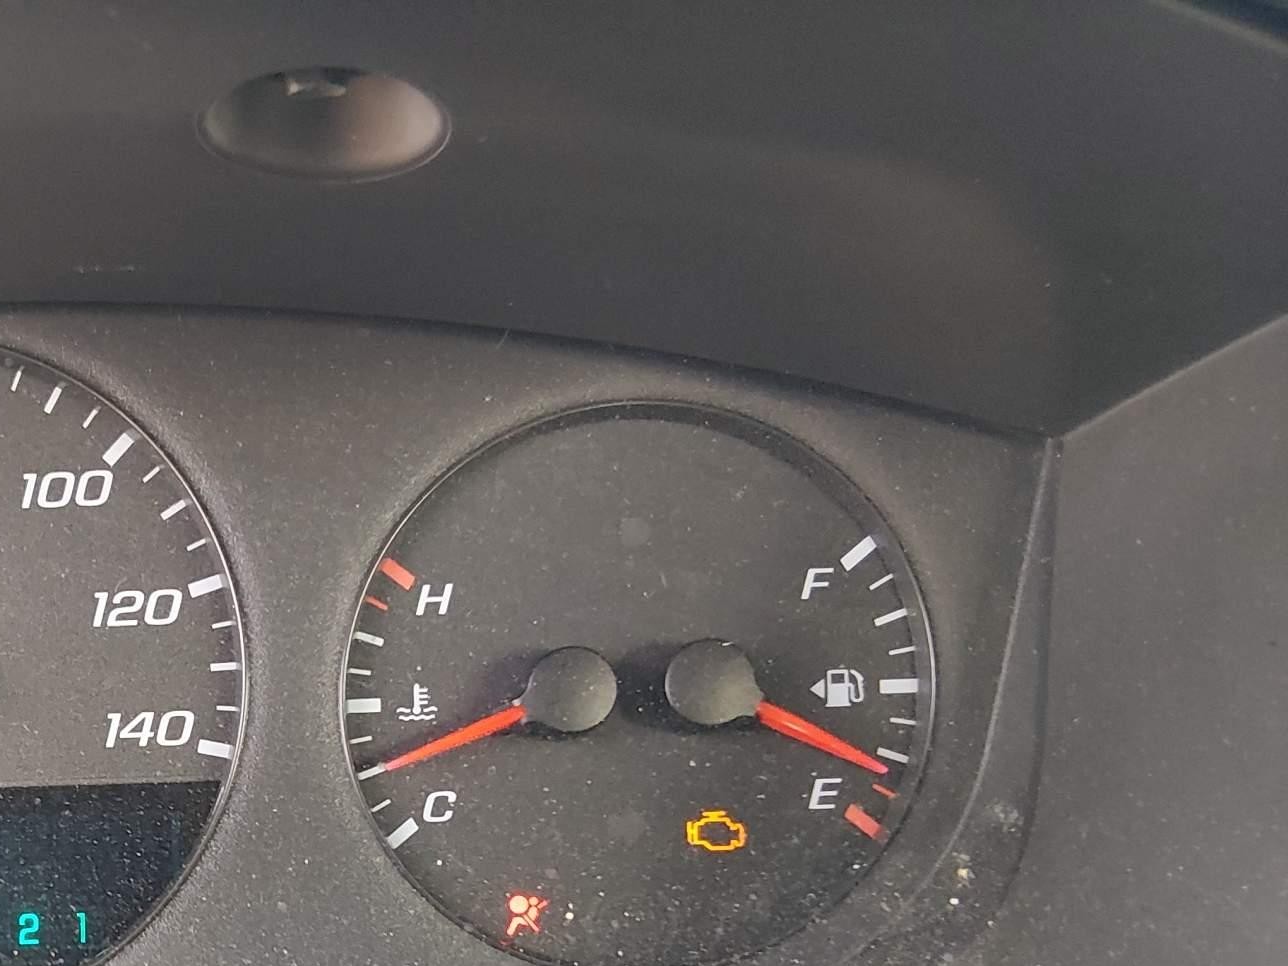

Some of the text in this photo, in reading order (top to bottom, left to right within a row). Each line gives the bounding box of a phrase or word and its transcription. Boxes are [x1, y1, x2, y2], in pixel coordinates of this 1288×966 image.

[20, 469, 114, 510] 100
[415, 582, 454, 617] H
[800, 567, 835, 600] F
[91, 588, 184, 628] 120
[104, 710, 196, 749] 140
[421, 790, 458, 824] C
[807, 776, 843, 811] E
[18, 912, 41, 946] 2
[74, 911, 87, 945] 1
